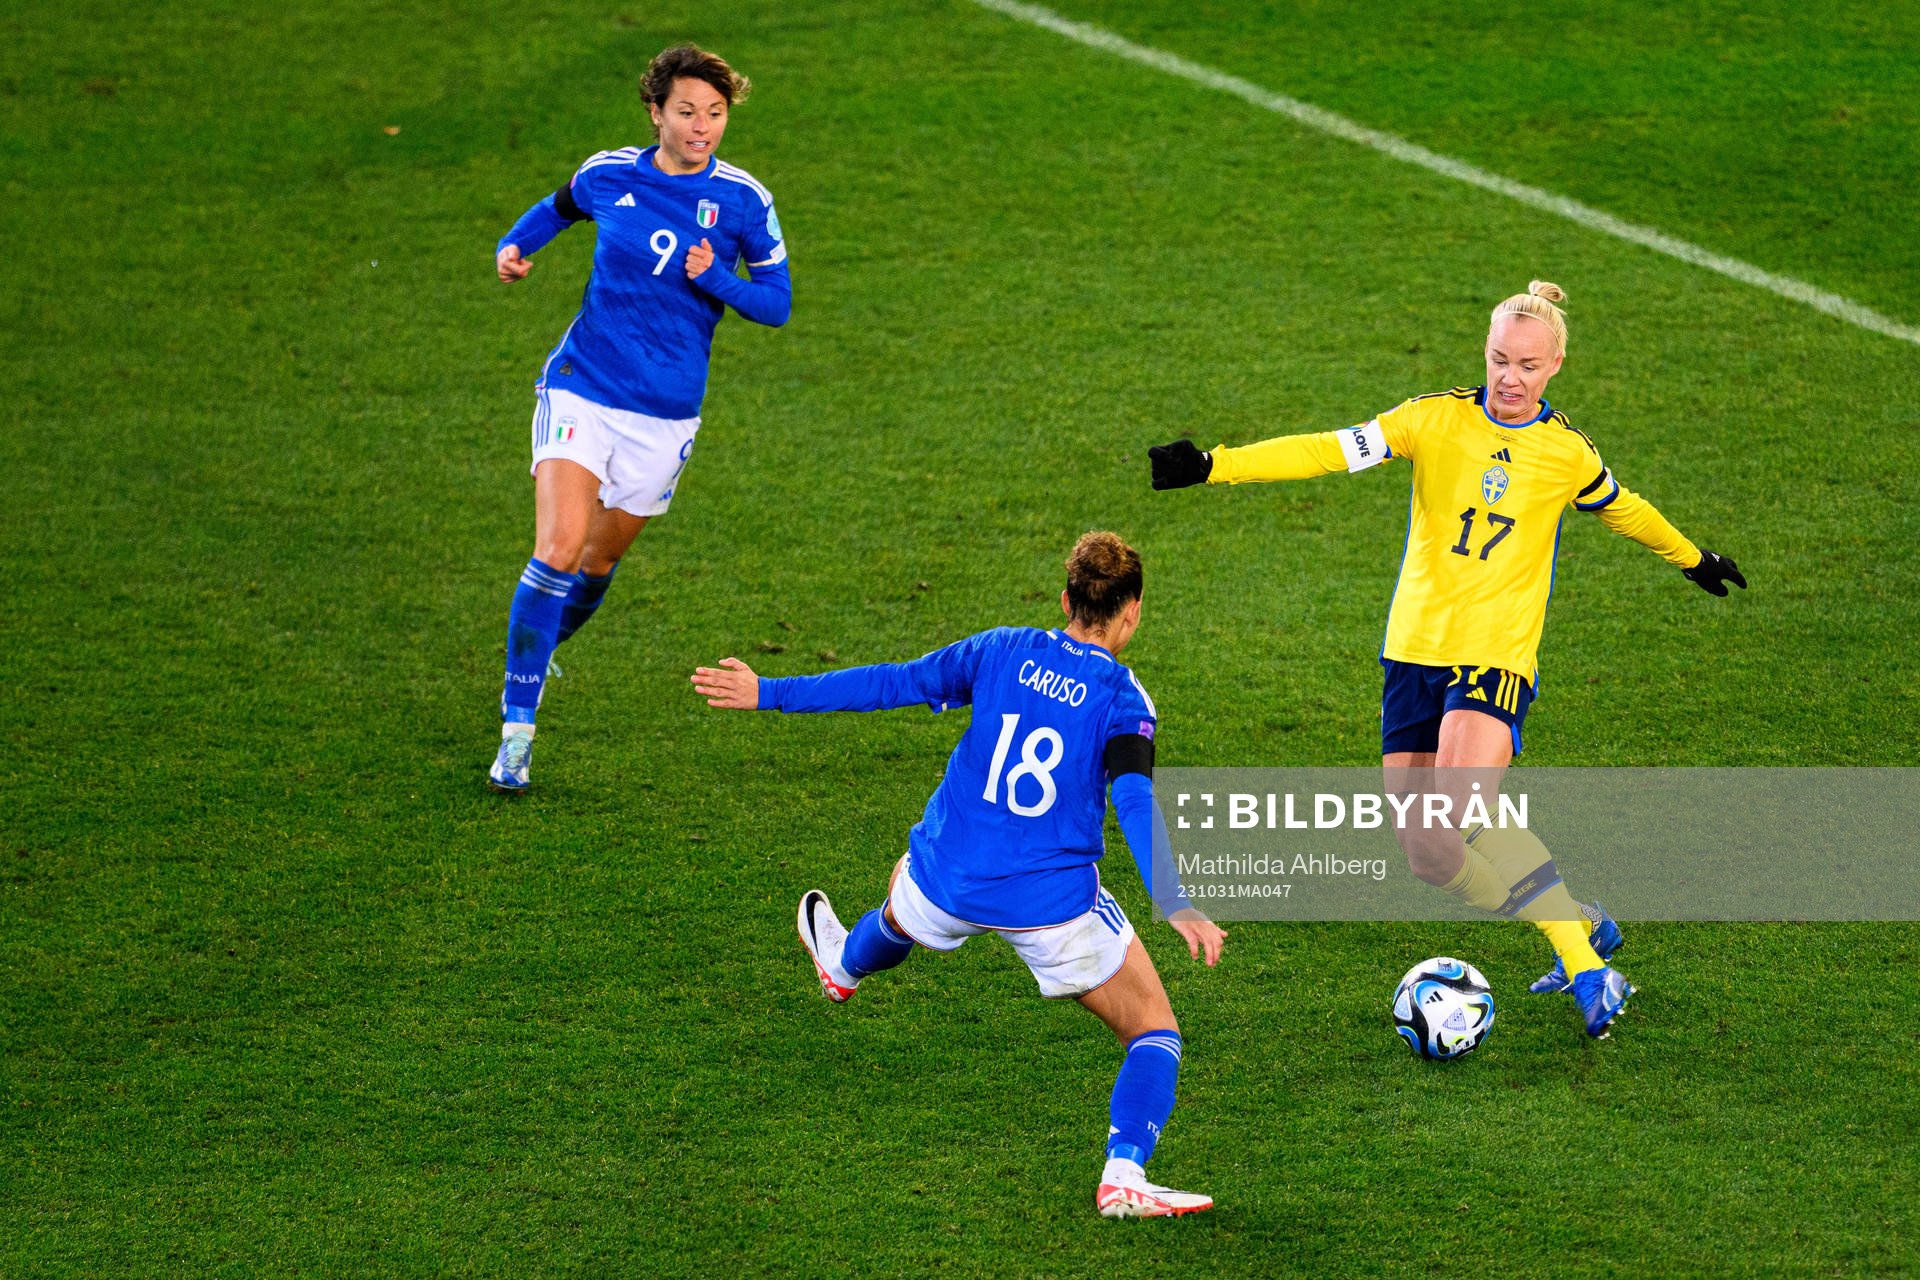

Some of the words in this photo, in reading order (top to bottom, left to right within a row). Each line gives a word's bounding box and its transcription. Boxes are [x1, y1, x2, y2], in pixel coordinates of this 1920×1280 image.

[649, 228, 679, 277] 9
[1352, 429, 1371, 458] LOVE
[1450, 506, 1516, 562] 17
[1061, 640, 1085, 658] ITALIA
[504, 671, 541, 684] ITALIA
[1018, 659, 1088, 708] CARUSO
[982, 713, 1065, 818] 18
